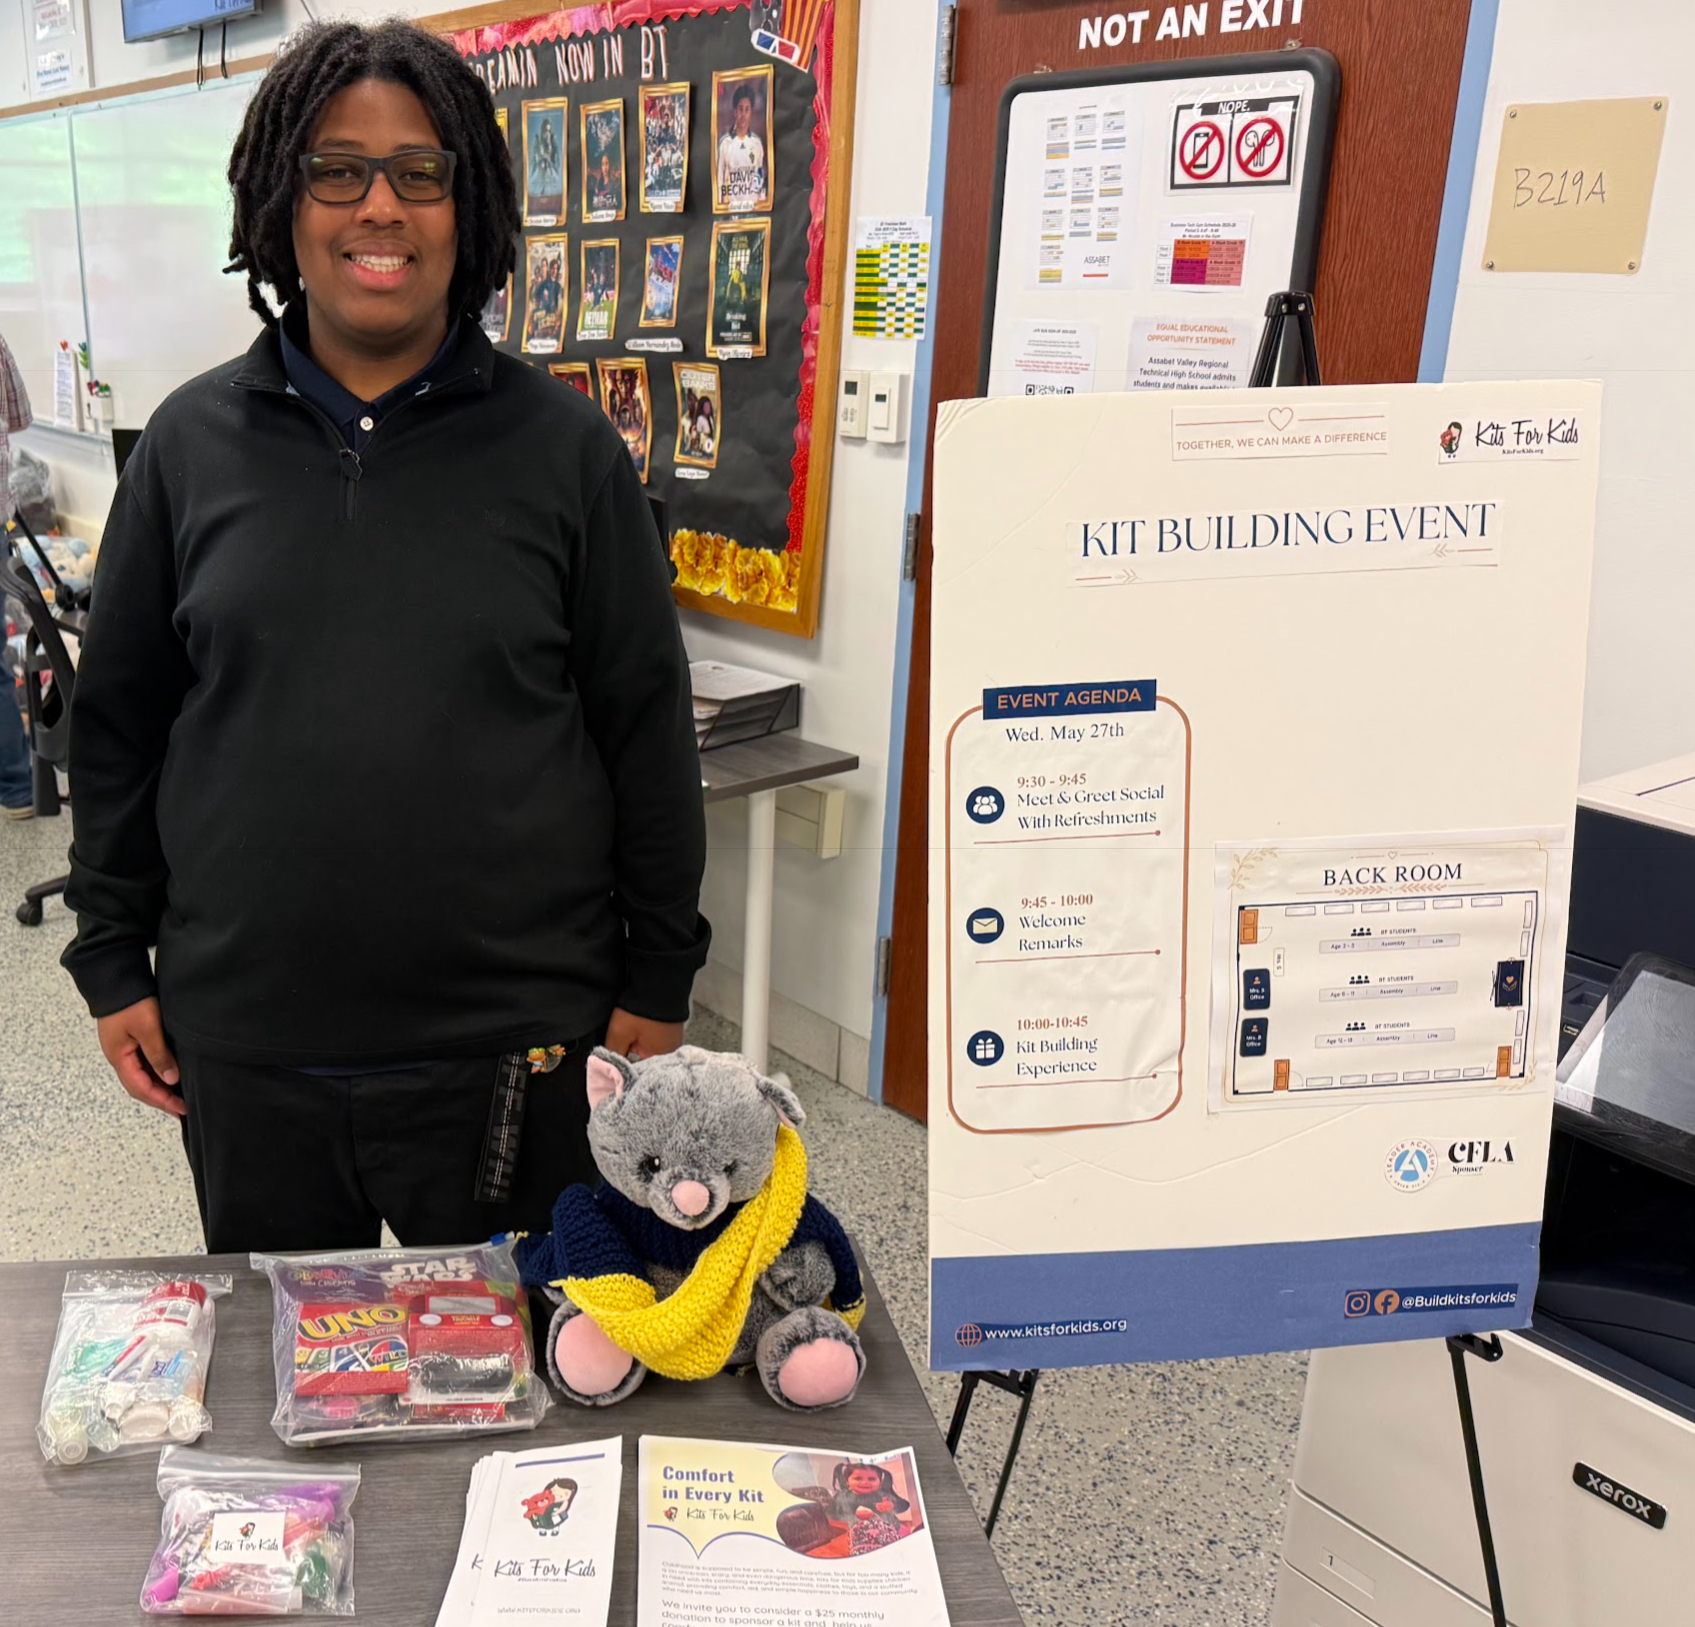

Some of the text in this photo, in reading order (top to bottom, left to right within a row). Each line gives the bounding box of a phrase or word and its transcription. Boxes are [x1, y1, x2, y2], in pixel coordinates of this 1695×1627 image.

[1079, 0, 1303, 50] NOT AN EXIT
[555, 40, 595, 86] NOW
[603, 34, 624, 80] IN
[641, 25, 668, 81] BT
[1218, 100, 1250, 114] NOPE.
[1513, 168, 1606, 209] B219A
[1156, 323, 1228, 333] EQUAL EDUCATIONAL
[1147, 334, 1236, 346] OPPORTUNITY STATEMENT
[1148, 357, 1229, 369] Assabet Valley Regional
[1133, 380, 1160, 389] students
[1162, 380, 1175, 389] and
[1139, 368, 1236, 382] Technical High School admits
[1176, 432, 1387, 451] TOGETHER, WE CAN MAKE A DIFFERENCE
[1475, 417, 1579, 447] Kits For Kids
[1081, 503, 1496, 558] KIT BUILDING EVENT
[998, 687, 1142, 710] EVENT AGENDA
[1005, 722, 1125, 743] Wed. May 27th
[1017, 775, 1046, 788] 9:30
[1059, 773, 1087, 786] 9:45
[1018, 785, 1165, 807] Meet & Greet Social
[1018, 810, 1157, 830] With Refreshments
[1323, 863, 1462, 886] BACK ROOM
[1021, 896, 1048, 910] 9:45
[1060, 894, 1094, 907] 10:00
[1019, 913, 1086, 929] Welcome
[1019, 935, 1083, 951] Remarks
[1017, 1016, 1088, 1030] 10:00-10:45
[1016, 1037, 1098, 1054] Kit Building
[1016, 1060, 1098, 1079] Experience
[391, 1257, 476, 1275] STAR
[1402, 1291, 1517, 1310] @Buildkitsforkids
[297, 1304, 407, 1341] UNO
[985, 1319, 1127, 1339] www.kitsforkids.org
[662, 1465, 735, 1484] Comfort
[662, 1486, 764, 1504] in Every Kit
[1586, 1472, 1651, 1520] xerox
[687, 1507, 755, 1522] Kits For Kids
[215, 1538, 279, 1551] Kits For Kids
[494, 1559, 525, 1578] Kits
[530, 1558, 560, 1577] For
[565, 1558, 596, 1577] Kids
[662, 1600, 680, 1609] We
[683, 1602, 713, 1612] invite
[716, 1605, 738, 1614] you
[740, 1604, 751, 1614] to
[754, 1605, 801, 1616] consider
[815, 1608, 836, 1618] $25
[838, 1609, 885, 1620] monthly
[662, 1611, 712, 1623] donation
[715, 1614, 726, 1624] to
[729, 1617, 774, 1627] sponsor
[787, 1617, 801, 1627] kit
